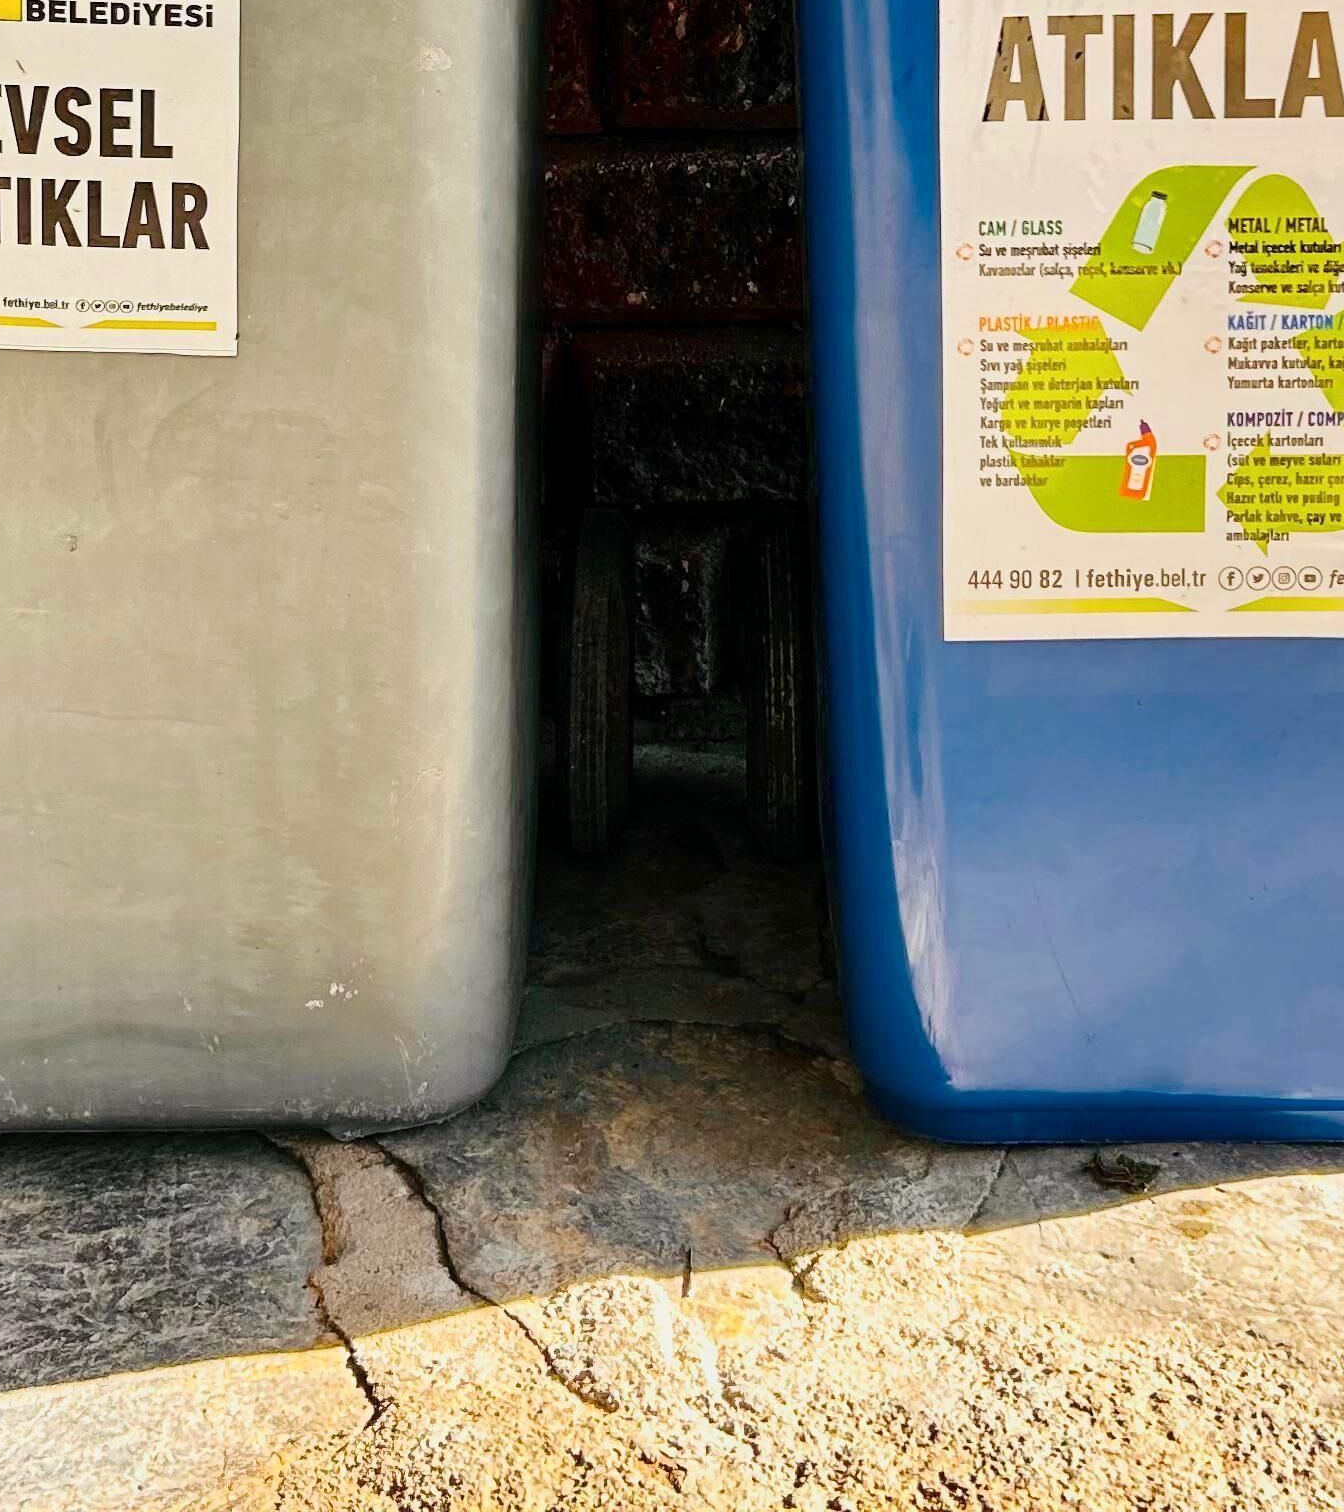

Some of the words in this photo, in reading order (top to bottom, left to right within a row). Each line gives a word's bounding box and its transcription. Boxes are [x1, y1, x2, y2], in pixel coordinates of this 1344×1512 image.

[979, 221, 1006, 236] CAM
[1022, 220, 1062, 235] GLASS
[1228, 218, 1271, 233] METAL
[1286, 217, 1328, 233] METAL
[979, 243, 991, 256] Su
[996, 245, 1006, 256] ve
[1229, 241, 1258, 253] Metal
[1228, 261, 1247, 276] Yağ
[1308, 263, 1319, 273] ve
[1228, 281, 1277, 293] Konserve
[1281, 283, 1293, 293] ve
[1297, 281, 1324, 296] salça
[979, 314, 1031, 332] PLASTİK
[1048, 315, 1099, 330] PLASTIC
[1228, 311, 1267, 330] KAĞIT
[1282, 315, 1333, 330] KARTON
[980, 339, 993, 352] Su
[997, 341, 1008, 352] ve
[1228, 337, 1256, 352] Kağıt
[980, 359, 1000, 371] Sıvı
[1004, 359, 1023, 374] yağ
[1027, 358, 1066, 374] şişeleri
[1228, 357, 1277, 369] Mukavva
[1032, 379, 1044, 390] ve
[1227, 376, 1274, 388] Yumurta
[1278, 376, 1333, 388] kartonları
[980, 397, 1015, 413] Yoğurt
[1018, 399, 1029, 409] ve
[1034, 397, 1081, 412] margarin
[1086, 396, 1123, 411] kapları
[980, 416, 1011, 432] Kargo
[1015, 418, 1027, 428] ve
[1031, 416, 1060, 432] kurye
[1227, 409, 1292, 427] KOMPOZİT
[980, 436, 998, 448] Tek
[1267, 433, 1323, 447] kartonları
[980, 455, 1016, 470] plastik
[1228, 453, 1249, 467] (süt
[1253, 456, 1266, 465] ve
[1270, 456, 1305, 468] meyve
[1309, 453, 1340, 465] suları
[980, 476, 992, 486] ve
[996, 474, 1048, 487] bardaklar
[1296, 473, 1323, 484] hazır
[1227, 492, 1255, 504] Hazır
[1286, 494, 1299, 503] ve
[1302, 492, 1339, 506] puding
[1227, 511, 1262, 523] Parlak
[1307, 513, 1326, 525] çay
[1330, 513, 1341, 522] ve
[1226, 529, 1289, 544] ambalajları
[968, 570, 1003, 589] 444
[1010, 570, 1032, 589] 90
[1039, 570, 1062, 589] 82
[1086, 569, 1206, 591] fethiye.bel.tr
